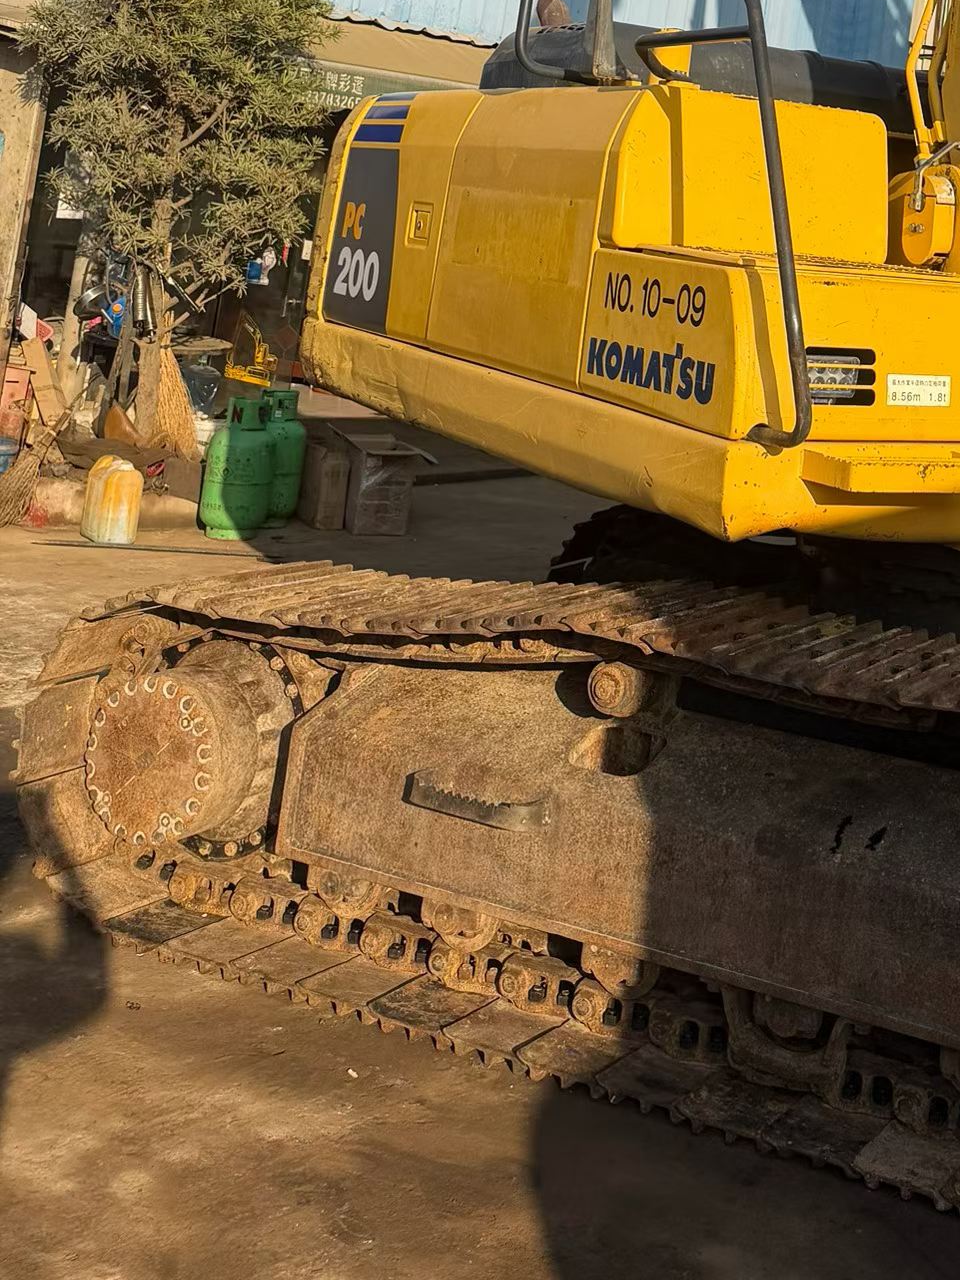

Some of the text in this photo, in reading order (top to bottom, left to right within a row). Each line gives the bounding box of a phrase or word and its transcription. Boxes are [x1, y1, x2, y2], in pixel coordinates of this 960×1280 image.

[341, 201, 366, 240] PC
[333, 246, 380, 302] 200
[604, 271, 706, 327] NO. 10-09
[587, 337, 716, 405] KOMATSU
[891, 391, 921, 402] 8.56m
